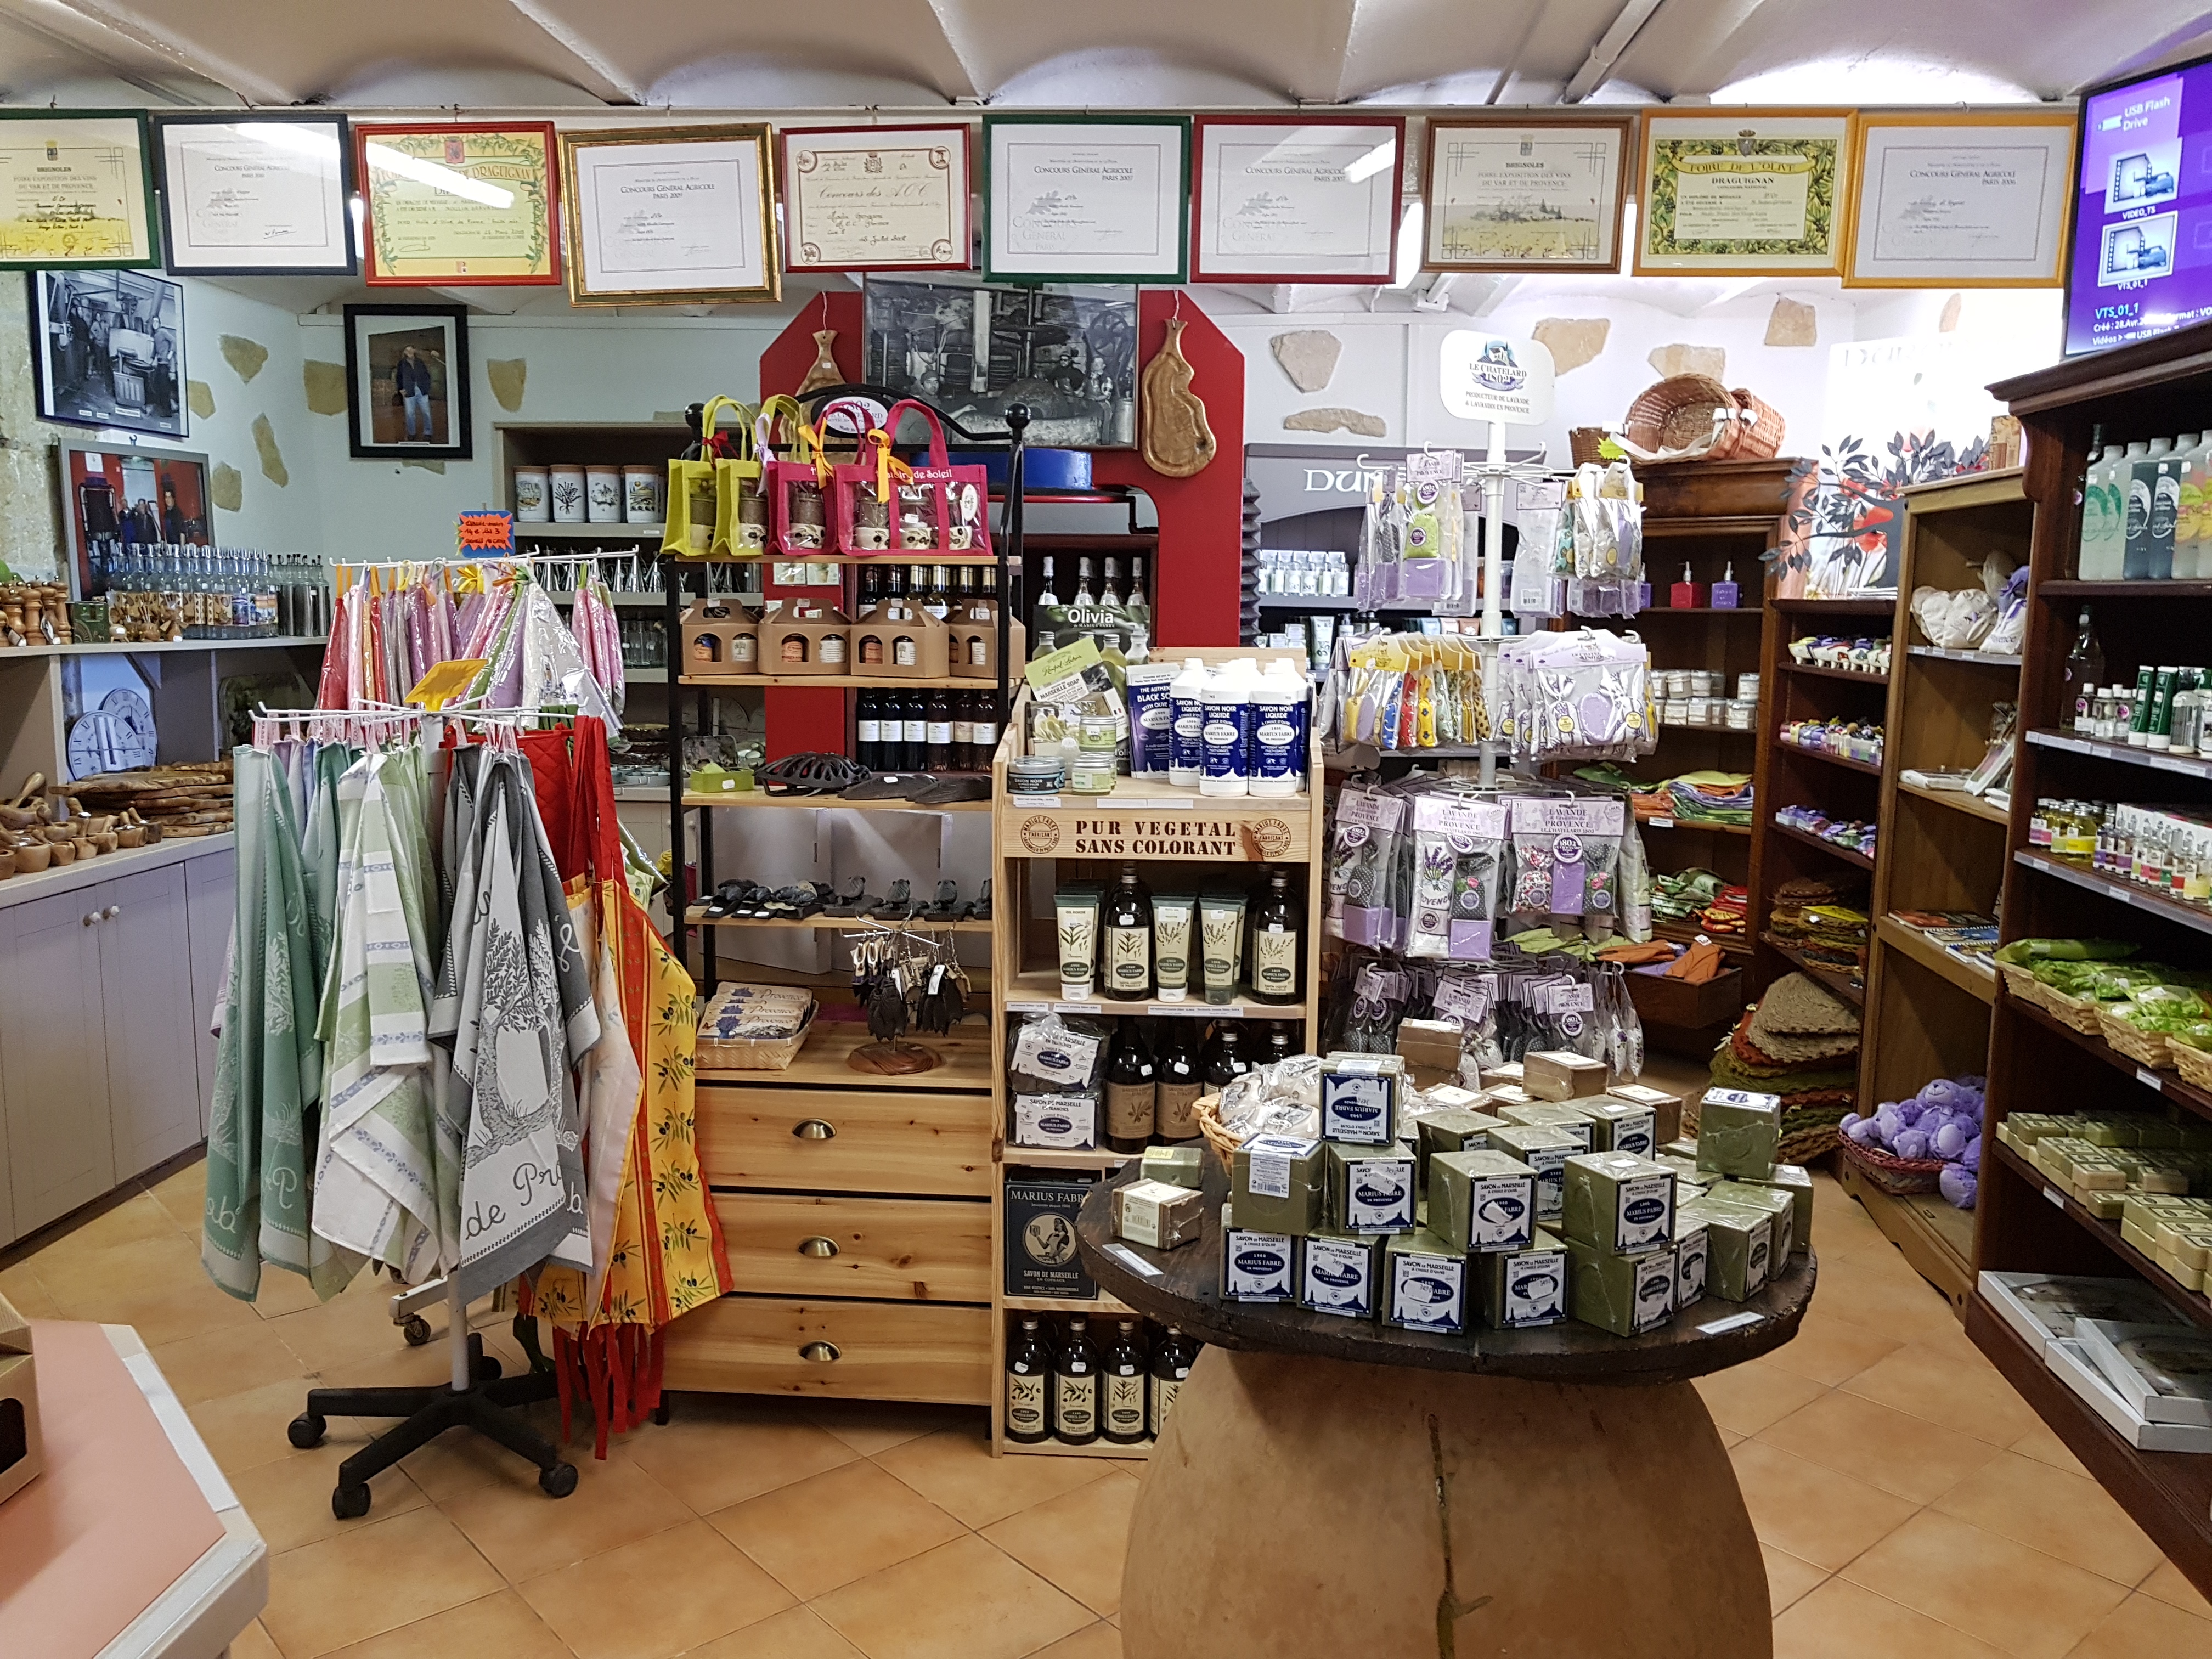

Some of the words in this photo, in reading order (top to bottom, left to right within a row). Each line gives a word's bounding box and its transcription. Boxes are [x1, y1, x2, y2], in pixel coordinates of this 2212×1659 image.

[2124, 103, 2144, 118] USB
[2145, 96, 2170, 112] Flash
[2123, 117, 2149, 132] Drive
[1245, 166, 1282, 174] CONCOURS
[2122, 206, 2156, 220] VIDEO_TS
[2095, 302, 2138, 319] VTS_01_1
[1481, 364, 1527, 377] CHATELARD
[1466, 391, 1498, 401] PRODUCTEUR
[1506, 397, 1530, 405] LAVANDE
[1471, 401, 1496, 409] LAVANDIN
[1504, 404, 1530, 414] PROVENCE
[927, 469, 953, 478] Soleil
[1068, 608, 1114, 624] Olivia
[1040, 684, 1067, 699] MARSEILLE
[1067, 678, 1080, 687] SOAP
[1137, 693, 1160, 703] BLACK
[1142, 703, 1154, 712] WITH
[1549, 808, 1588, 816] LAVANDE
[1023, 816, 1041, 832] MARIUS
[1042, 816, 1058, 831] FABRE
[1075, 820, 1121, 836] PUR
[1135, 821, 1237, 837] VEGETAL
[1254, 820, 1271, 835] MARIUS
[1273, 820, 1289, 835] FABRE
[1438, 820, 1481, 831] PROVENCE
[1076, 839, 1125, 855] SANS
[1132, 839, 1237, 856] COLORANT
[1355, 1105, 1378, 1114] MARIUS
[1011, 1190, 1054, 1201] MARIUS
[1057, 1193, 1084, 1203] FABR
[1627, 1207, 1646, 1216] MARIUS
[1647, 1206, 1662, 1214] FABRE
[476, 1201, 506, 1240] de
[1335, 1248, 1362, 1257] MARSEILLE
[1426, 1263, 1454, 1272] MARSEILLE
[1023, 1270, 1041, 1278] SAVON
[1049, 1271, 1079, 1279] MARSEILLE
[1339, 1272, 1359, 1280] FABRE
